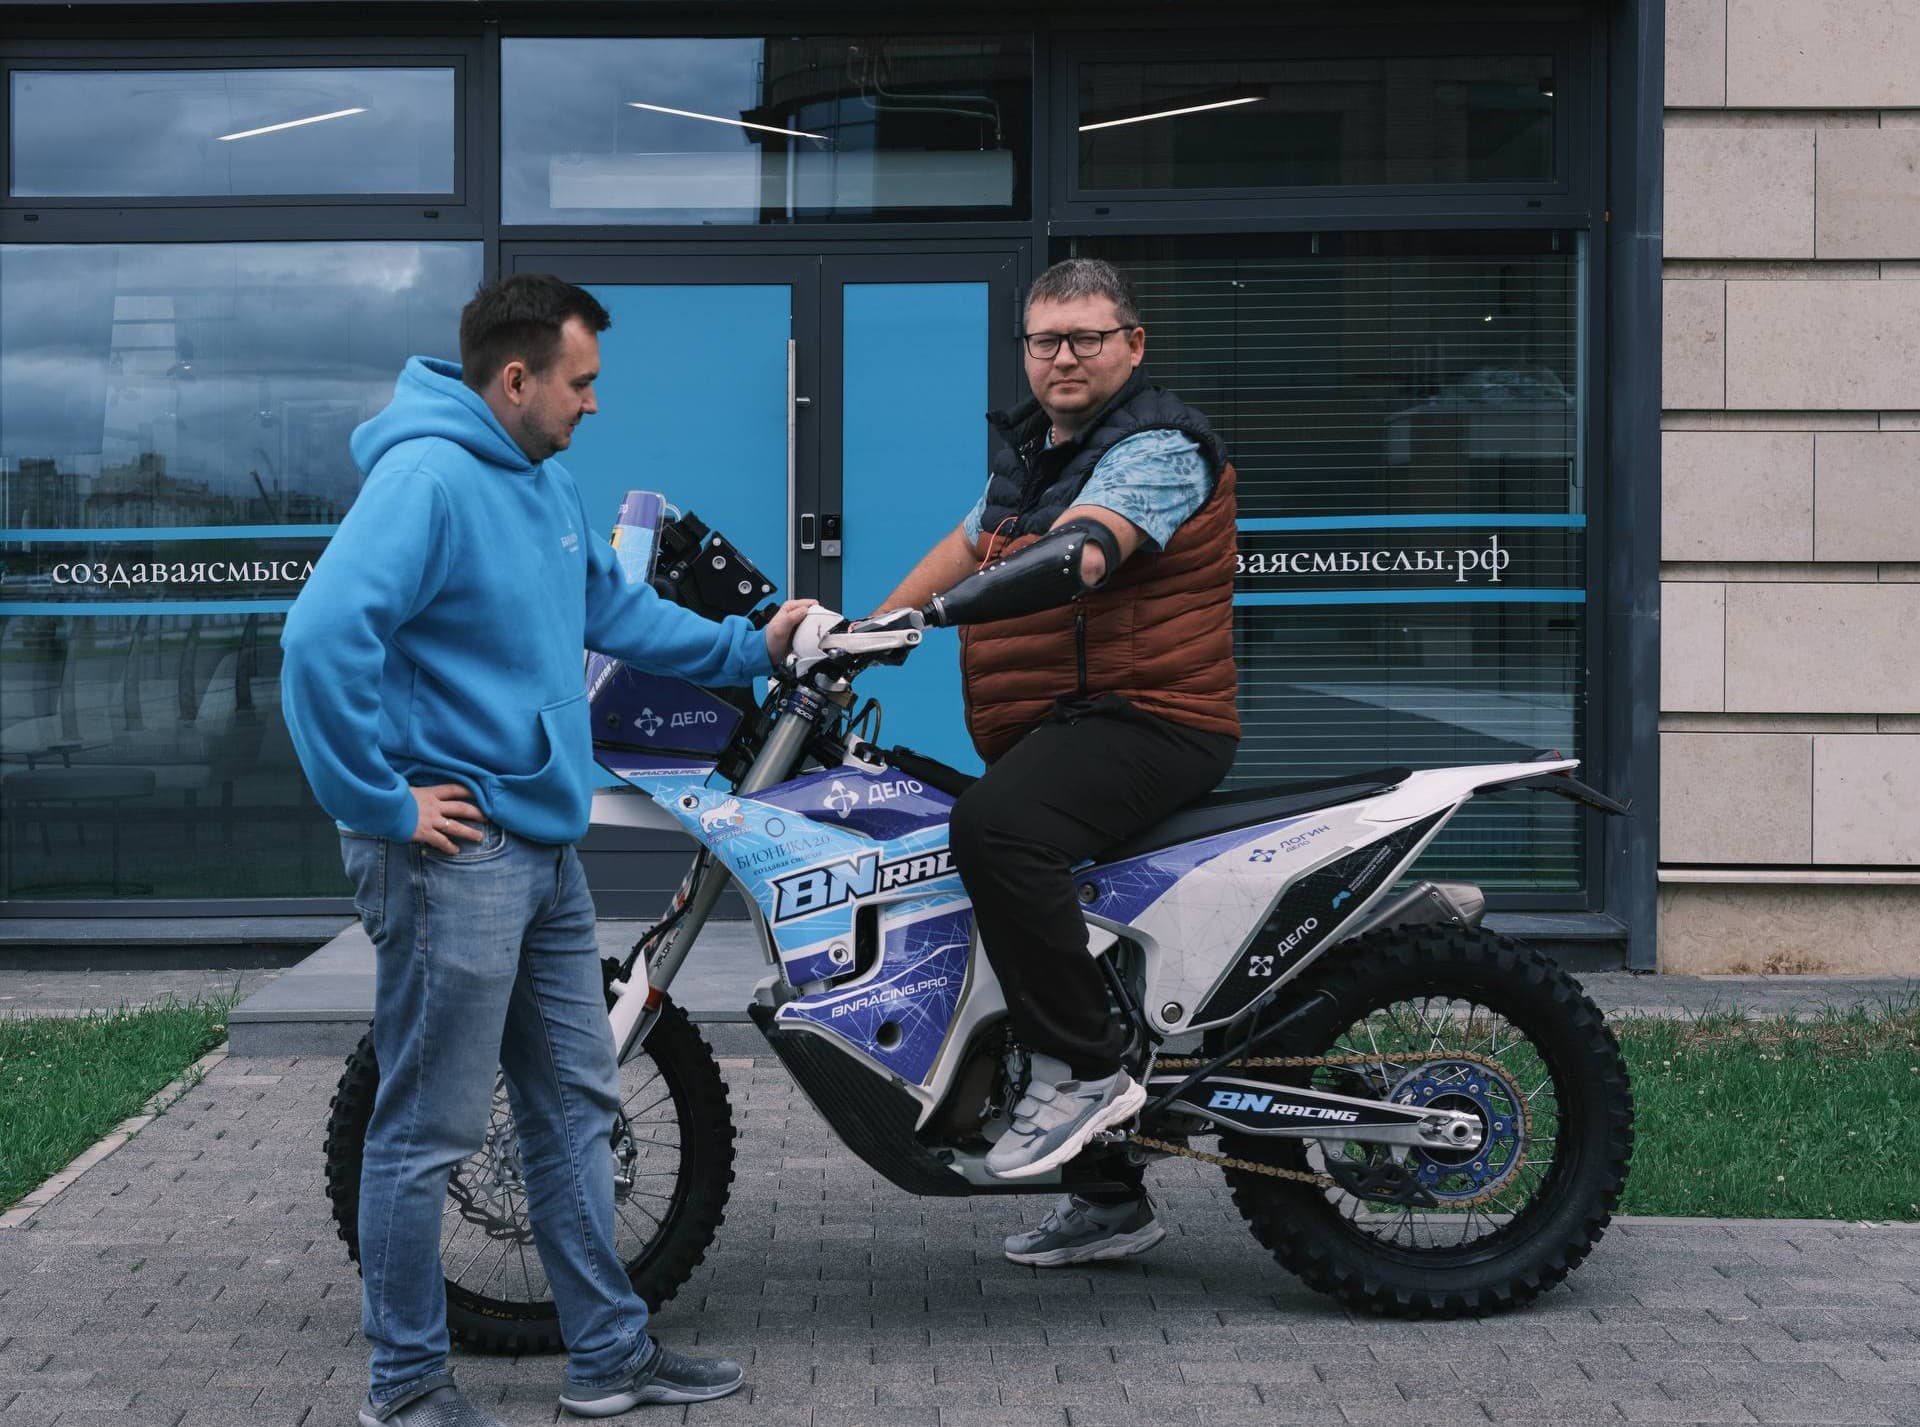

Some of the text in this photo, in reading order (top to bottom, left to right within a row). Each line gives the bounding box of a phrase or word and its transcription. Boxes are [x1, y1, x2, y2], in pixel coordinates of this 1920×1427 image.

[670, 711, 718, 728] ДЕЛО
[867, 780, 923, 805] ДЕЛО
[1280, 825, 1331, 848] ЛОГИН
[1286, 840, 1311, 853] ДЕЛО
[736, 838, 812, 870] БИОНИКА
[775, 852, 879, 921] BN
[1277, 917, 1318, 957] ДЕЛО
[831, 976, 948, 1018] BNRACING.PRO
[1207, 1090, 1360, 1122] BN RACING
